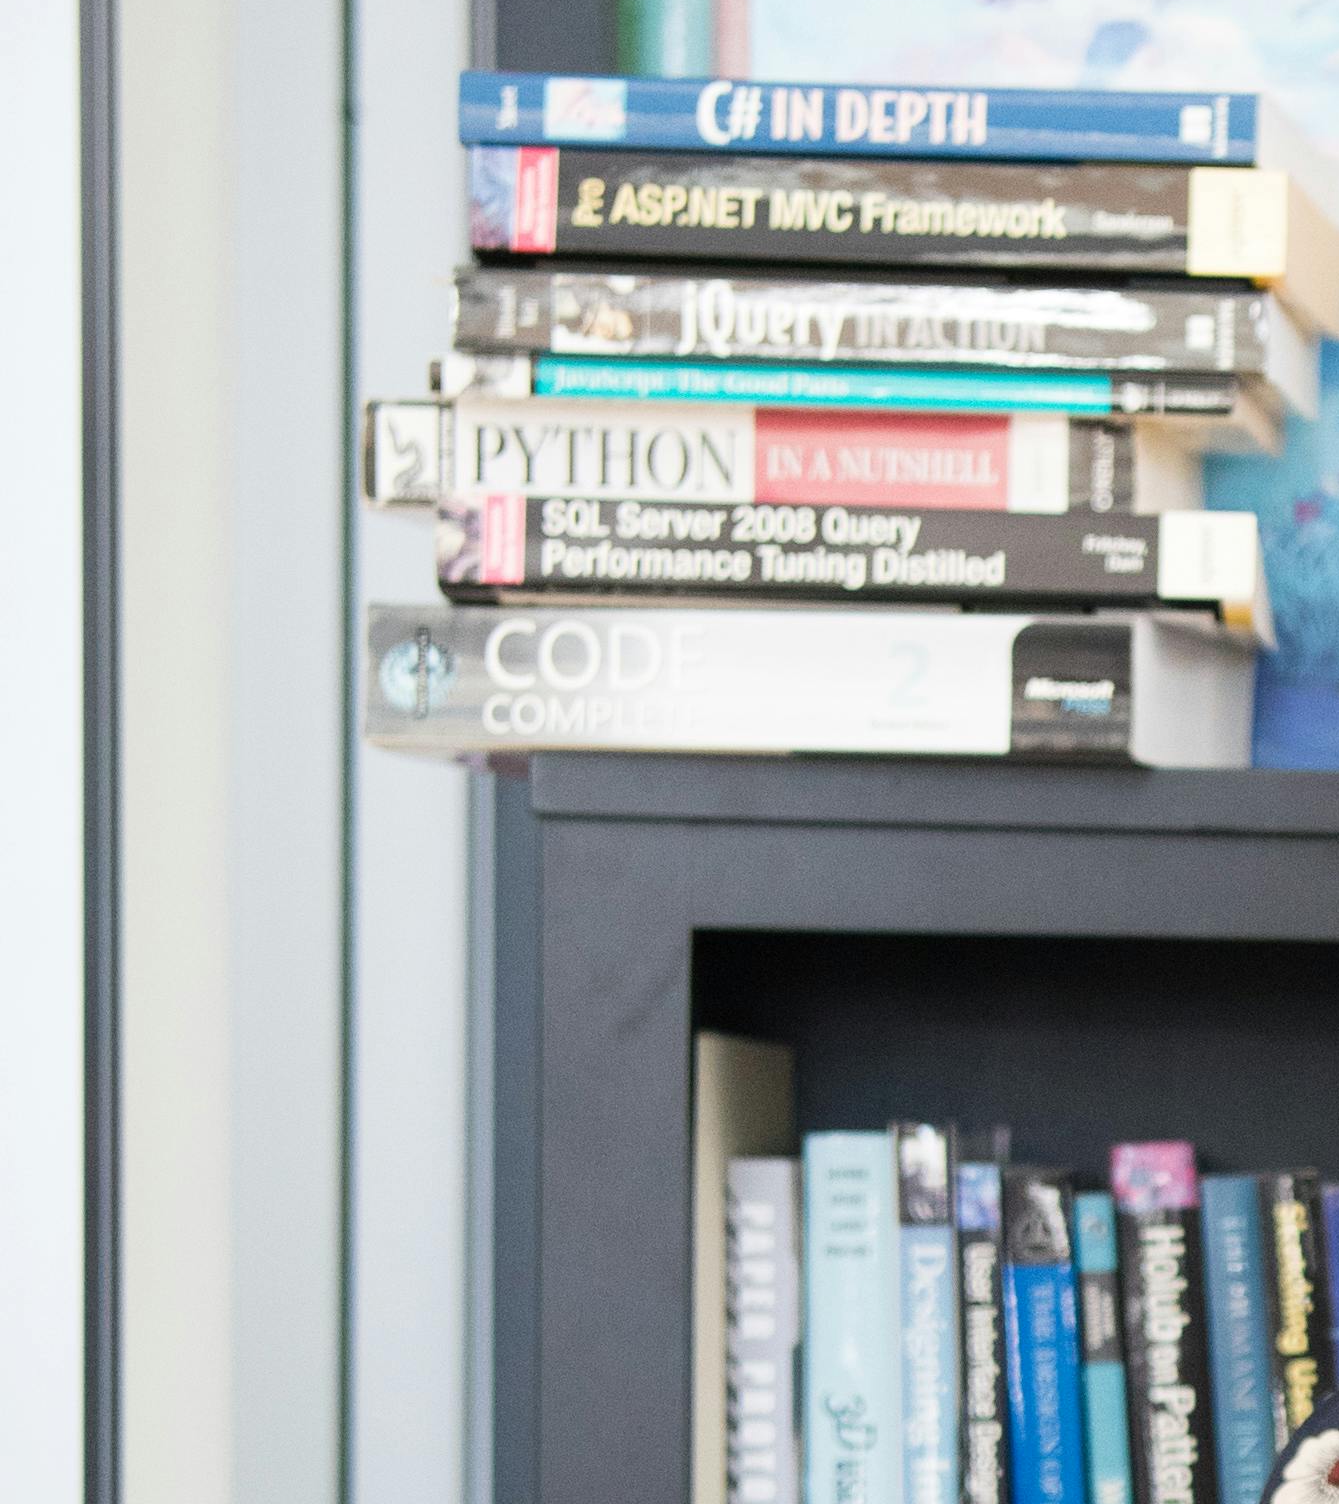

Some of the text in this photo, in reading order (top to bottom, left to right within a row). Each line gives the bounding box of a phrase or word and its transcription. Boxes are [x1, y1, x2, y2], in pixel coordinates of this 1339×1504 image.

[696, 80, 989, 147] C# IN DEPTH
[609, 182, 1068, 241] ASP.NET MVC Framework
[678, 277, 847, 362] jQuery
[677, 364, 724, 393] The
[727, 367, 791, 395] Good
[473, 423, 1000, 489] PYTHON IN A NUTSHELL
[540, 498, 922, 557] SQL Server 2008 Query
[540, 539, 1007, 591] Performance Tuning Distilled
[482, 617, 706, 694] CODE
[966, 1243, 1001, 1295] User
[1146, 1225, 1193, 1344] Holub
[905, 1242, 958, 1446] Designing
[967, 1306, 1003, 1420] Interface
